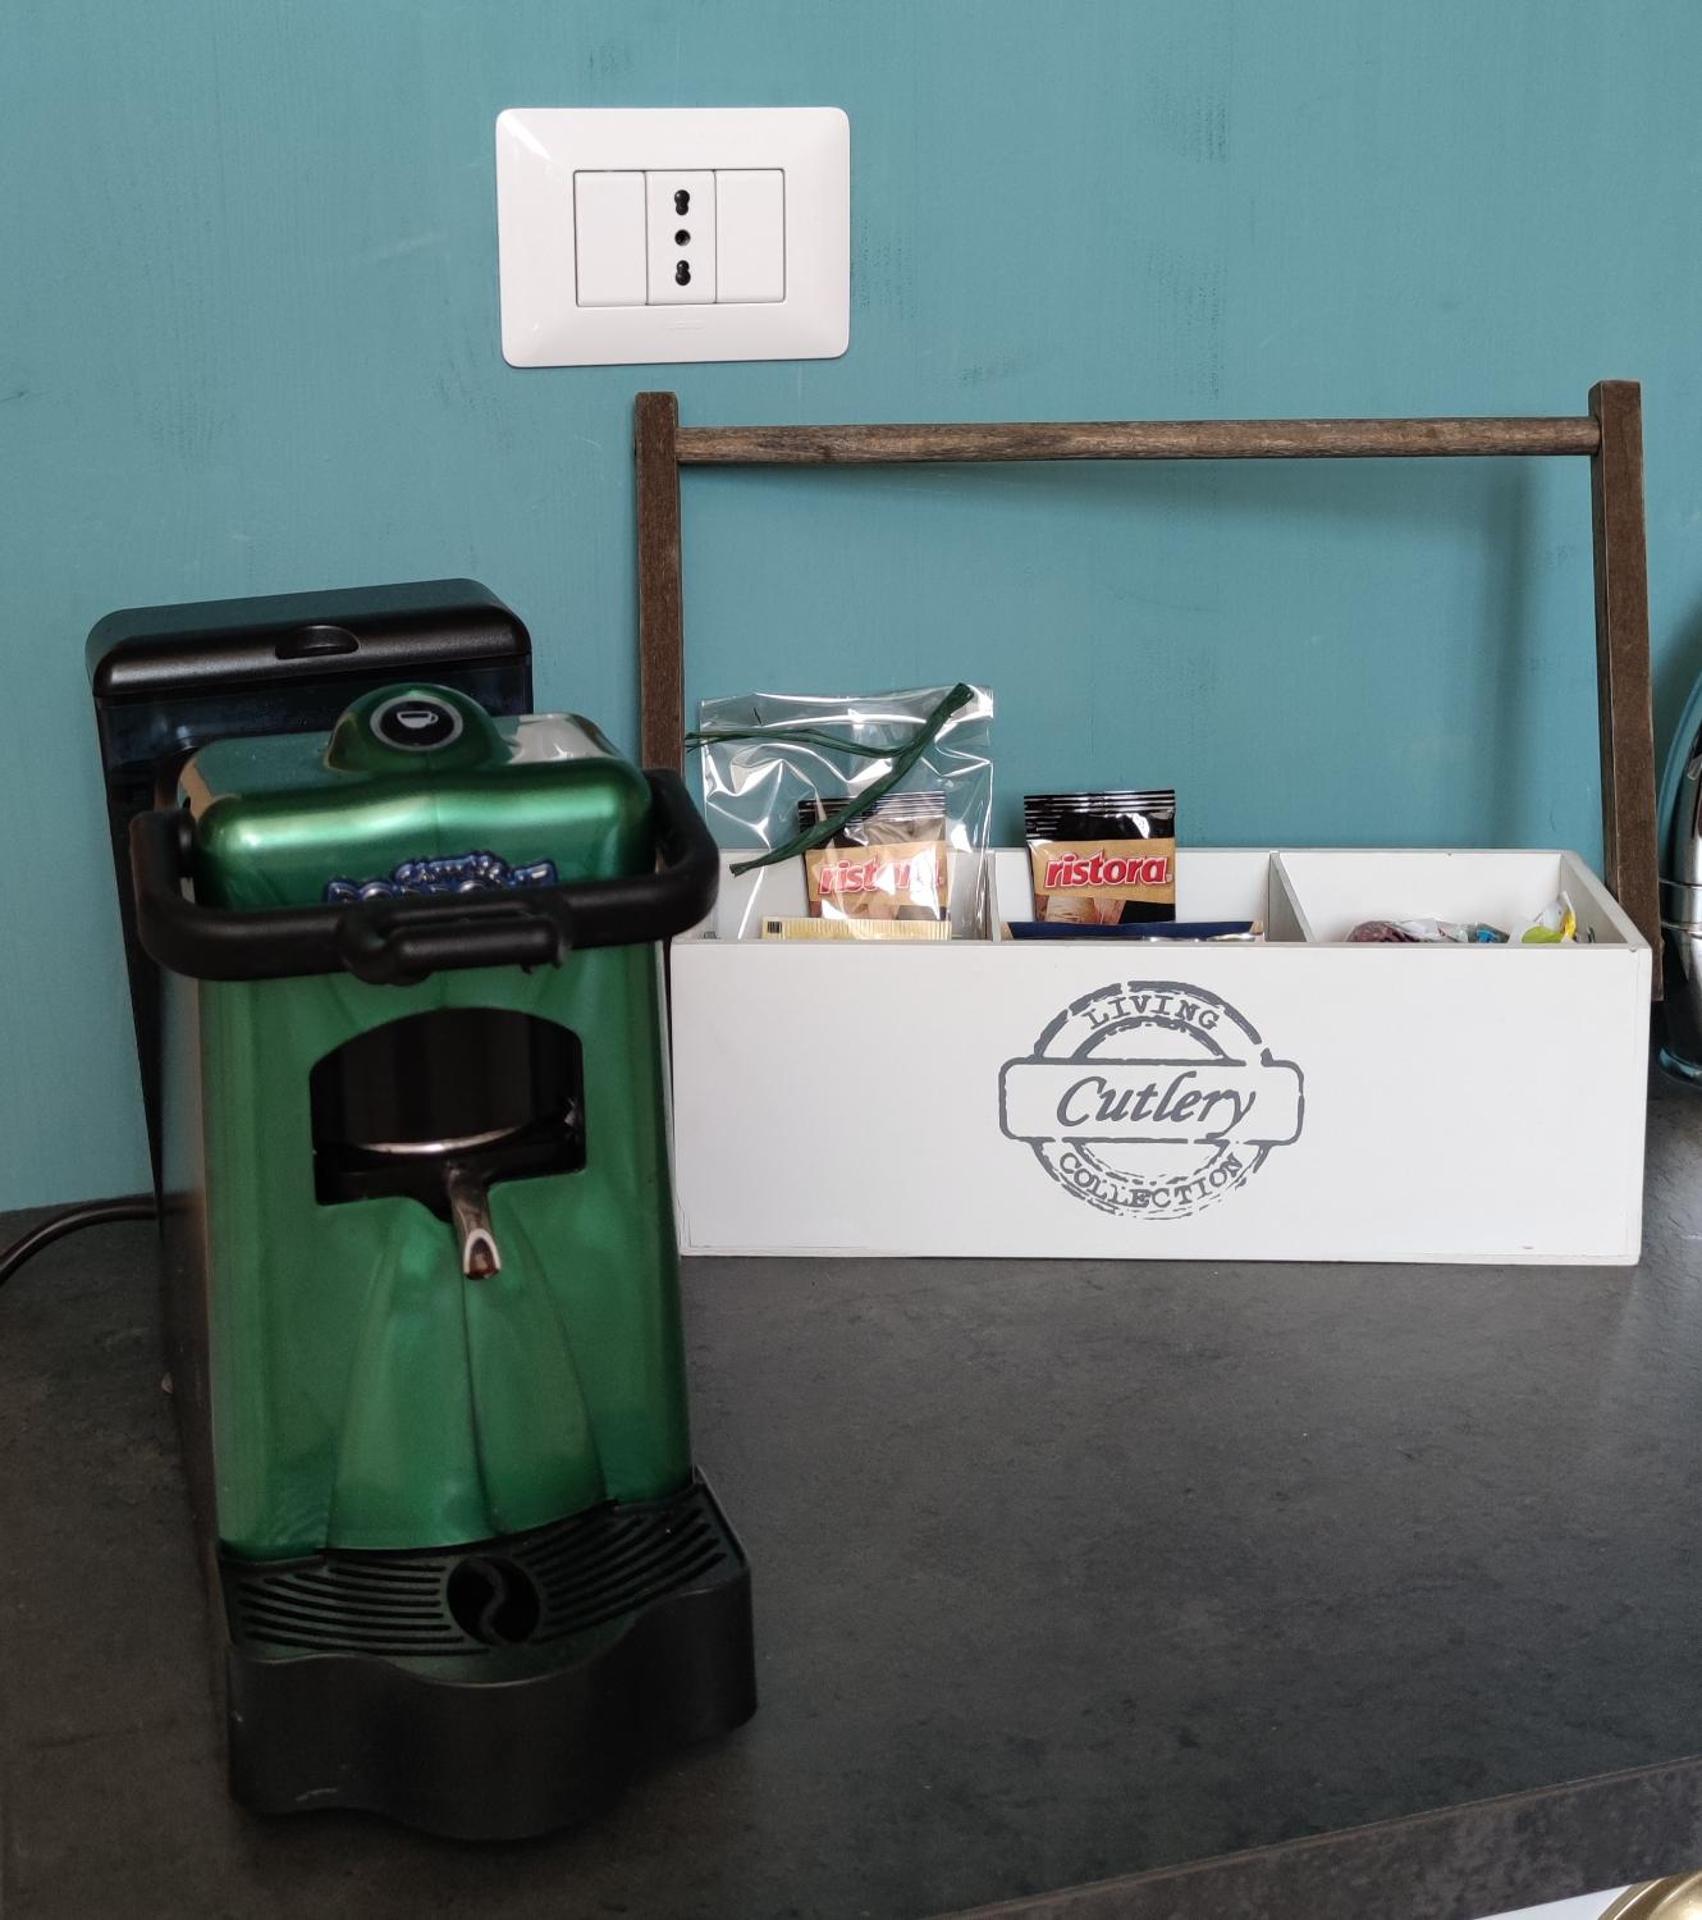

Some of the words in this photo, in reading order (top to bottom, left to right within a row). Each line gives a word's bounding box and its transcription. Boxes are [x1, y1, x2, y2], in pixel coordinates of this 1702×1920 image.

[1045, 849, 1168, 888] ristora
[1081, 994, 1220, 1030] LIVING
[1056, 1070, 1256, 1140] Cutlery
[1059, 1151, 1243, 1208] COLLECTION
